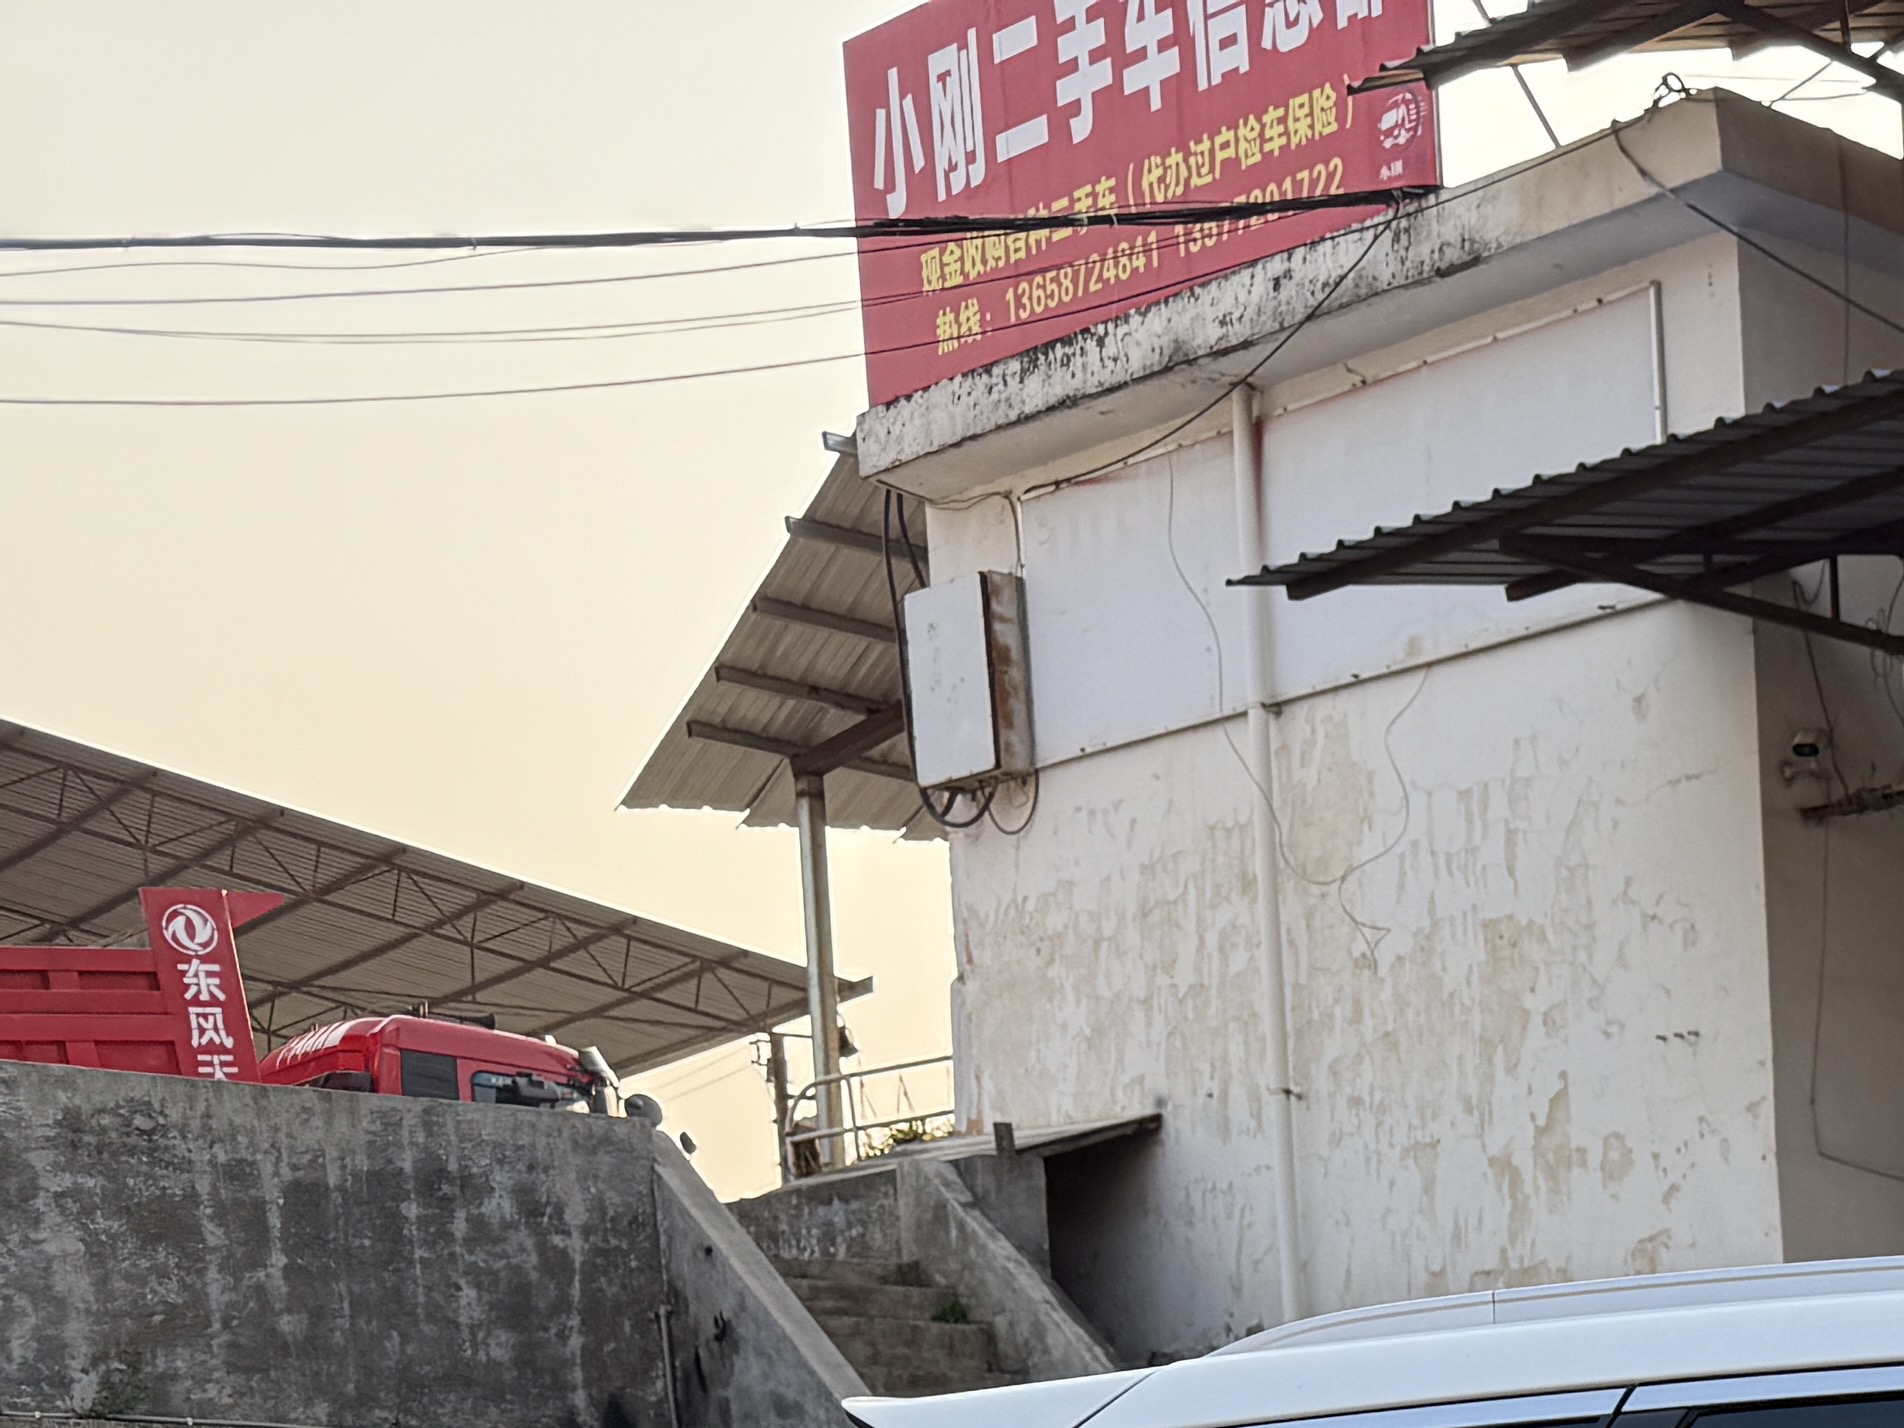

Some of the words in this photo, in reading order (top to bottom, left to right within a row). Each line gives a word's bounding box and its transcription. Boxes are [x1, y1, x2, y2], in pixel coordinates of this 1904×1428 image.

[873, 0, 1383, 219] 小刚二手车信
[1006, 230, 1160, 323] 13658724841
